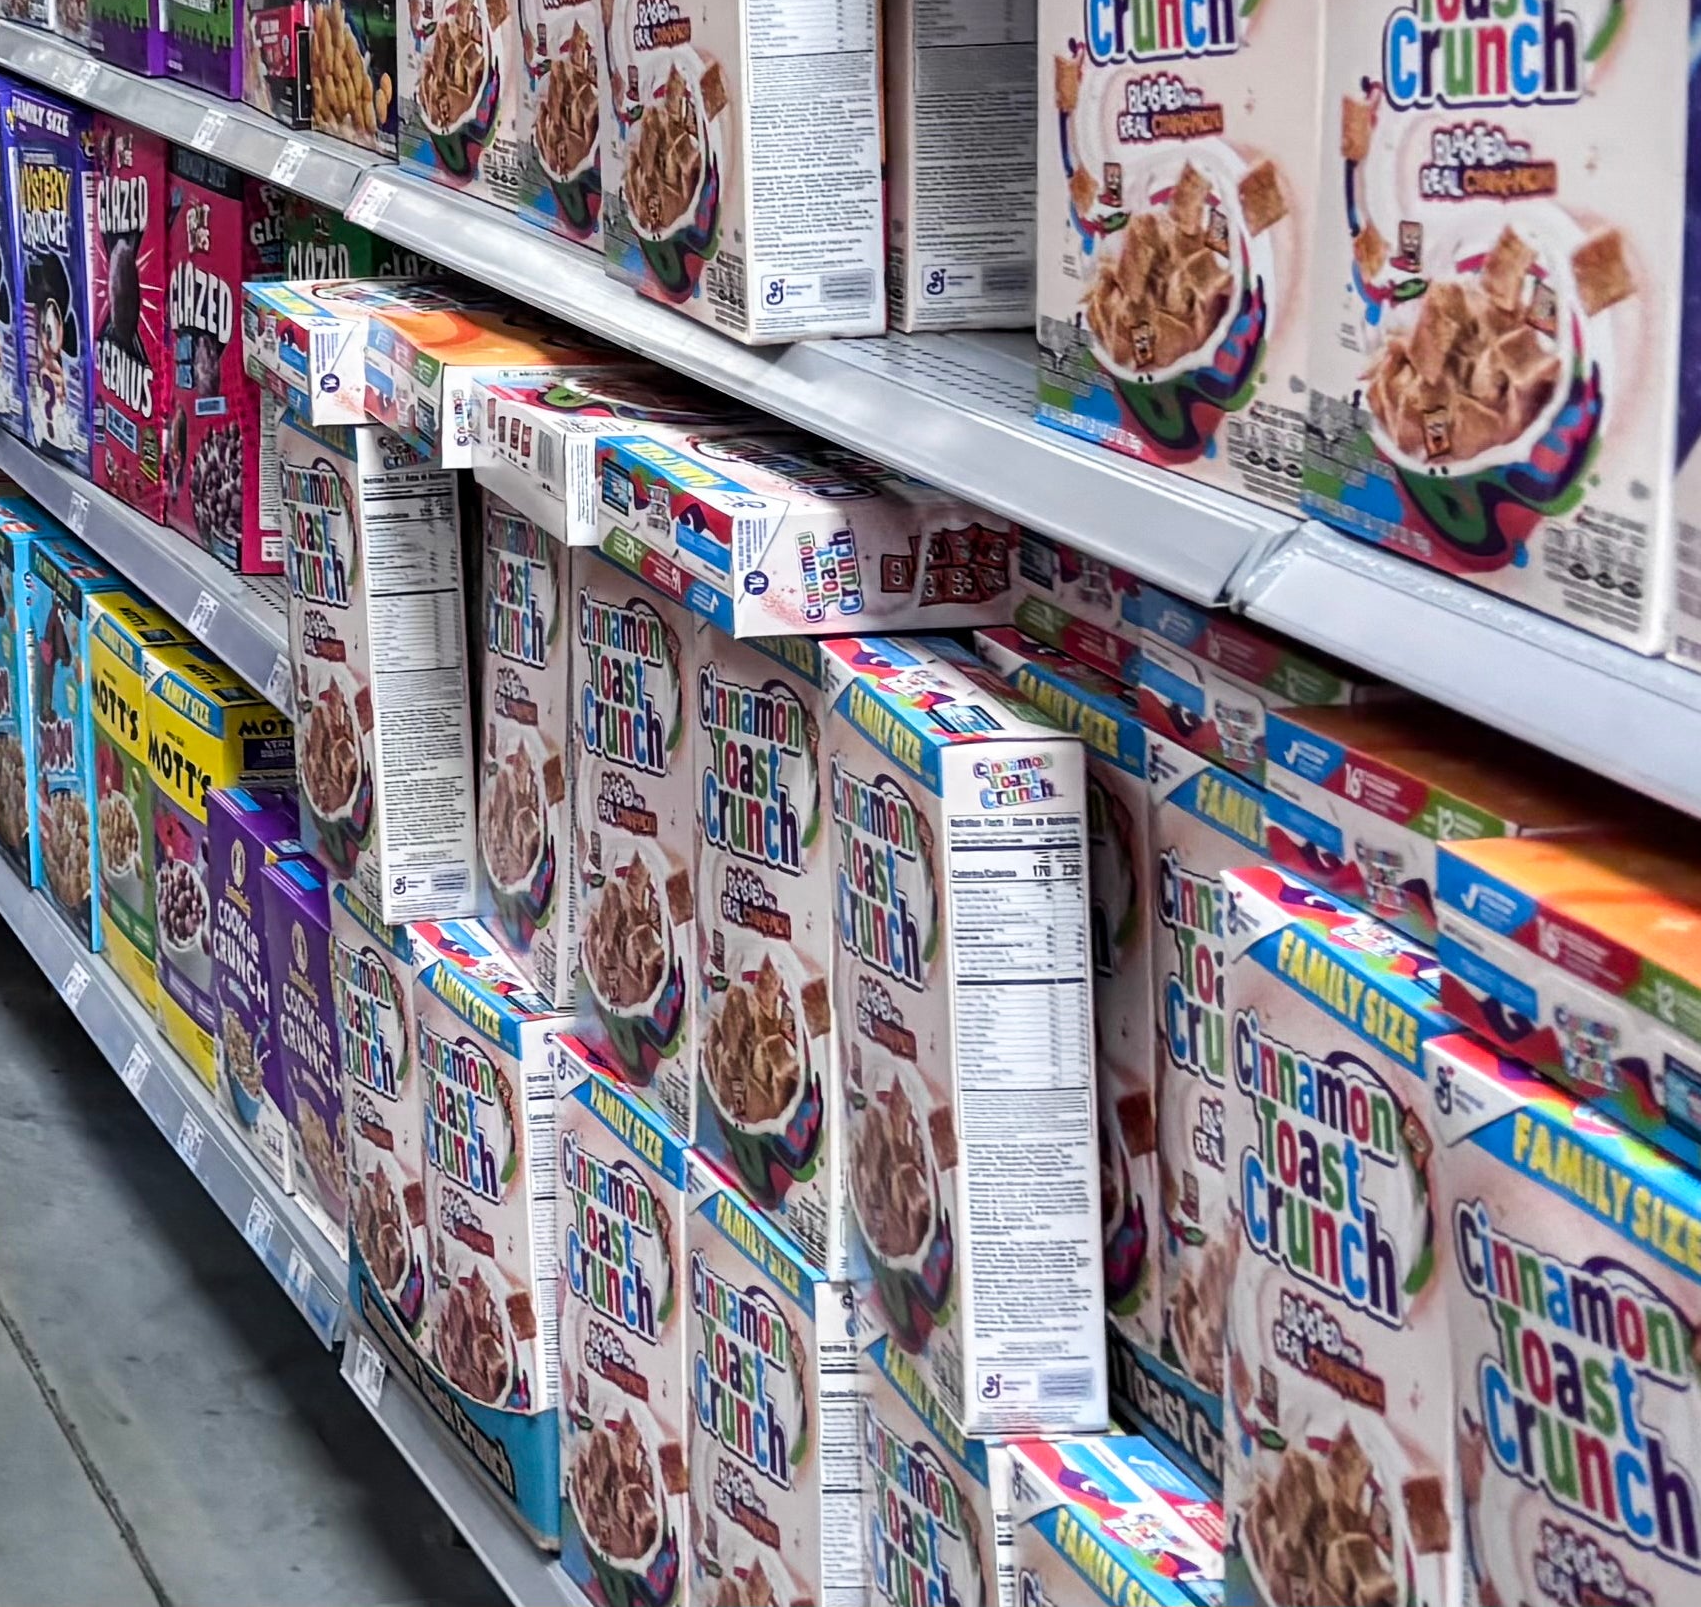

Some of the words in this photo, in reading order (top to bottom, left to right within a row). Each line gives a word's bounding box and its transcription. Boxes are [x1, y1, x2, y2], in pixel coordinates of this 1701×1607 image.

[1119, 114, 1152, 140] REAL
[1433, 127, 1503, 165] BLASTED
[97, 176, 149, 233] GLAZED
[1422, 165, 1462, 196] REAL
[169, 265, 233, 345] GLAZED
[102, 343, 154, 418] GENIUS
[580, 594, 663, 663] Cinnamon
[240, 717, 294, 736] MOT
[700, 665, 800, 747] Cinnamon
[149, 728, 212, 806] MOTT'S
[988, 771, 1038, 790] Toast
[1346, 763, 1361, 798] 16
[705, 766, 798, 873] Crunch
[1032, 864, 1051, 878] 170
[1538, 916, 1558, 956] 16
[1278, 929, 1364, 1022] FAMILY
[1364, 989, 1418, 1061] SIZE
[592, 1081, 631, 1134] FAMILY
[631, 1114, 663, 1163] SIZE
[1236, 1012, 1397, 1156] Cinnamon
[563, 1134, 651, 1223] Cinnamon
[1259, 1099, 1363, 1218] Toast
[1244, 1154, 1398, 1319] Crunch
[568, 1228, 656, 1342] Crunch
[1458, 1206, 1686, 1378] Cinnamon
[1498, 1304, 1647, 1449] Toast
[1483, 1362, 1700, 1560] Crunch
